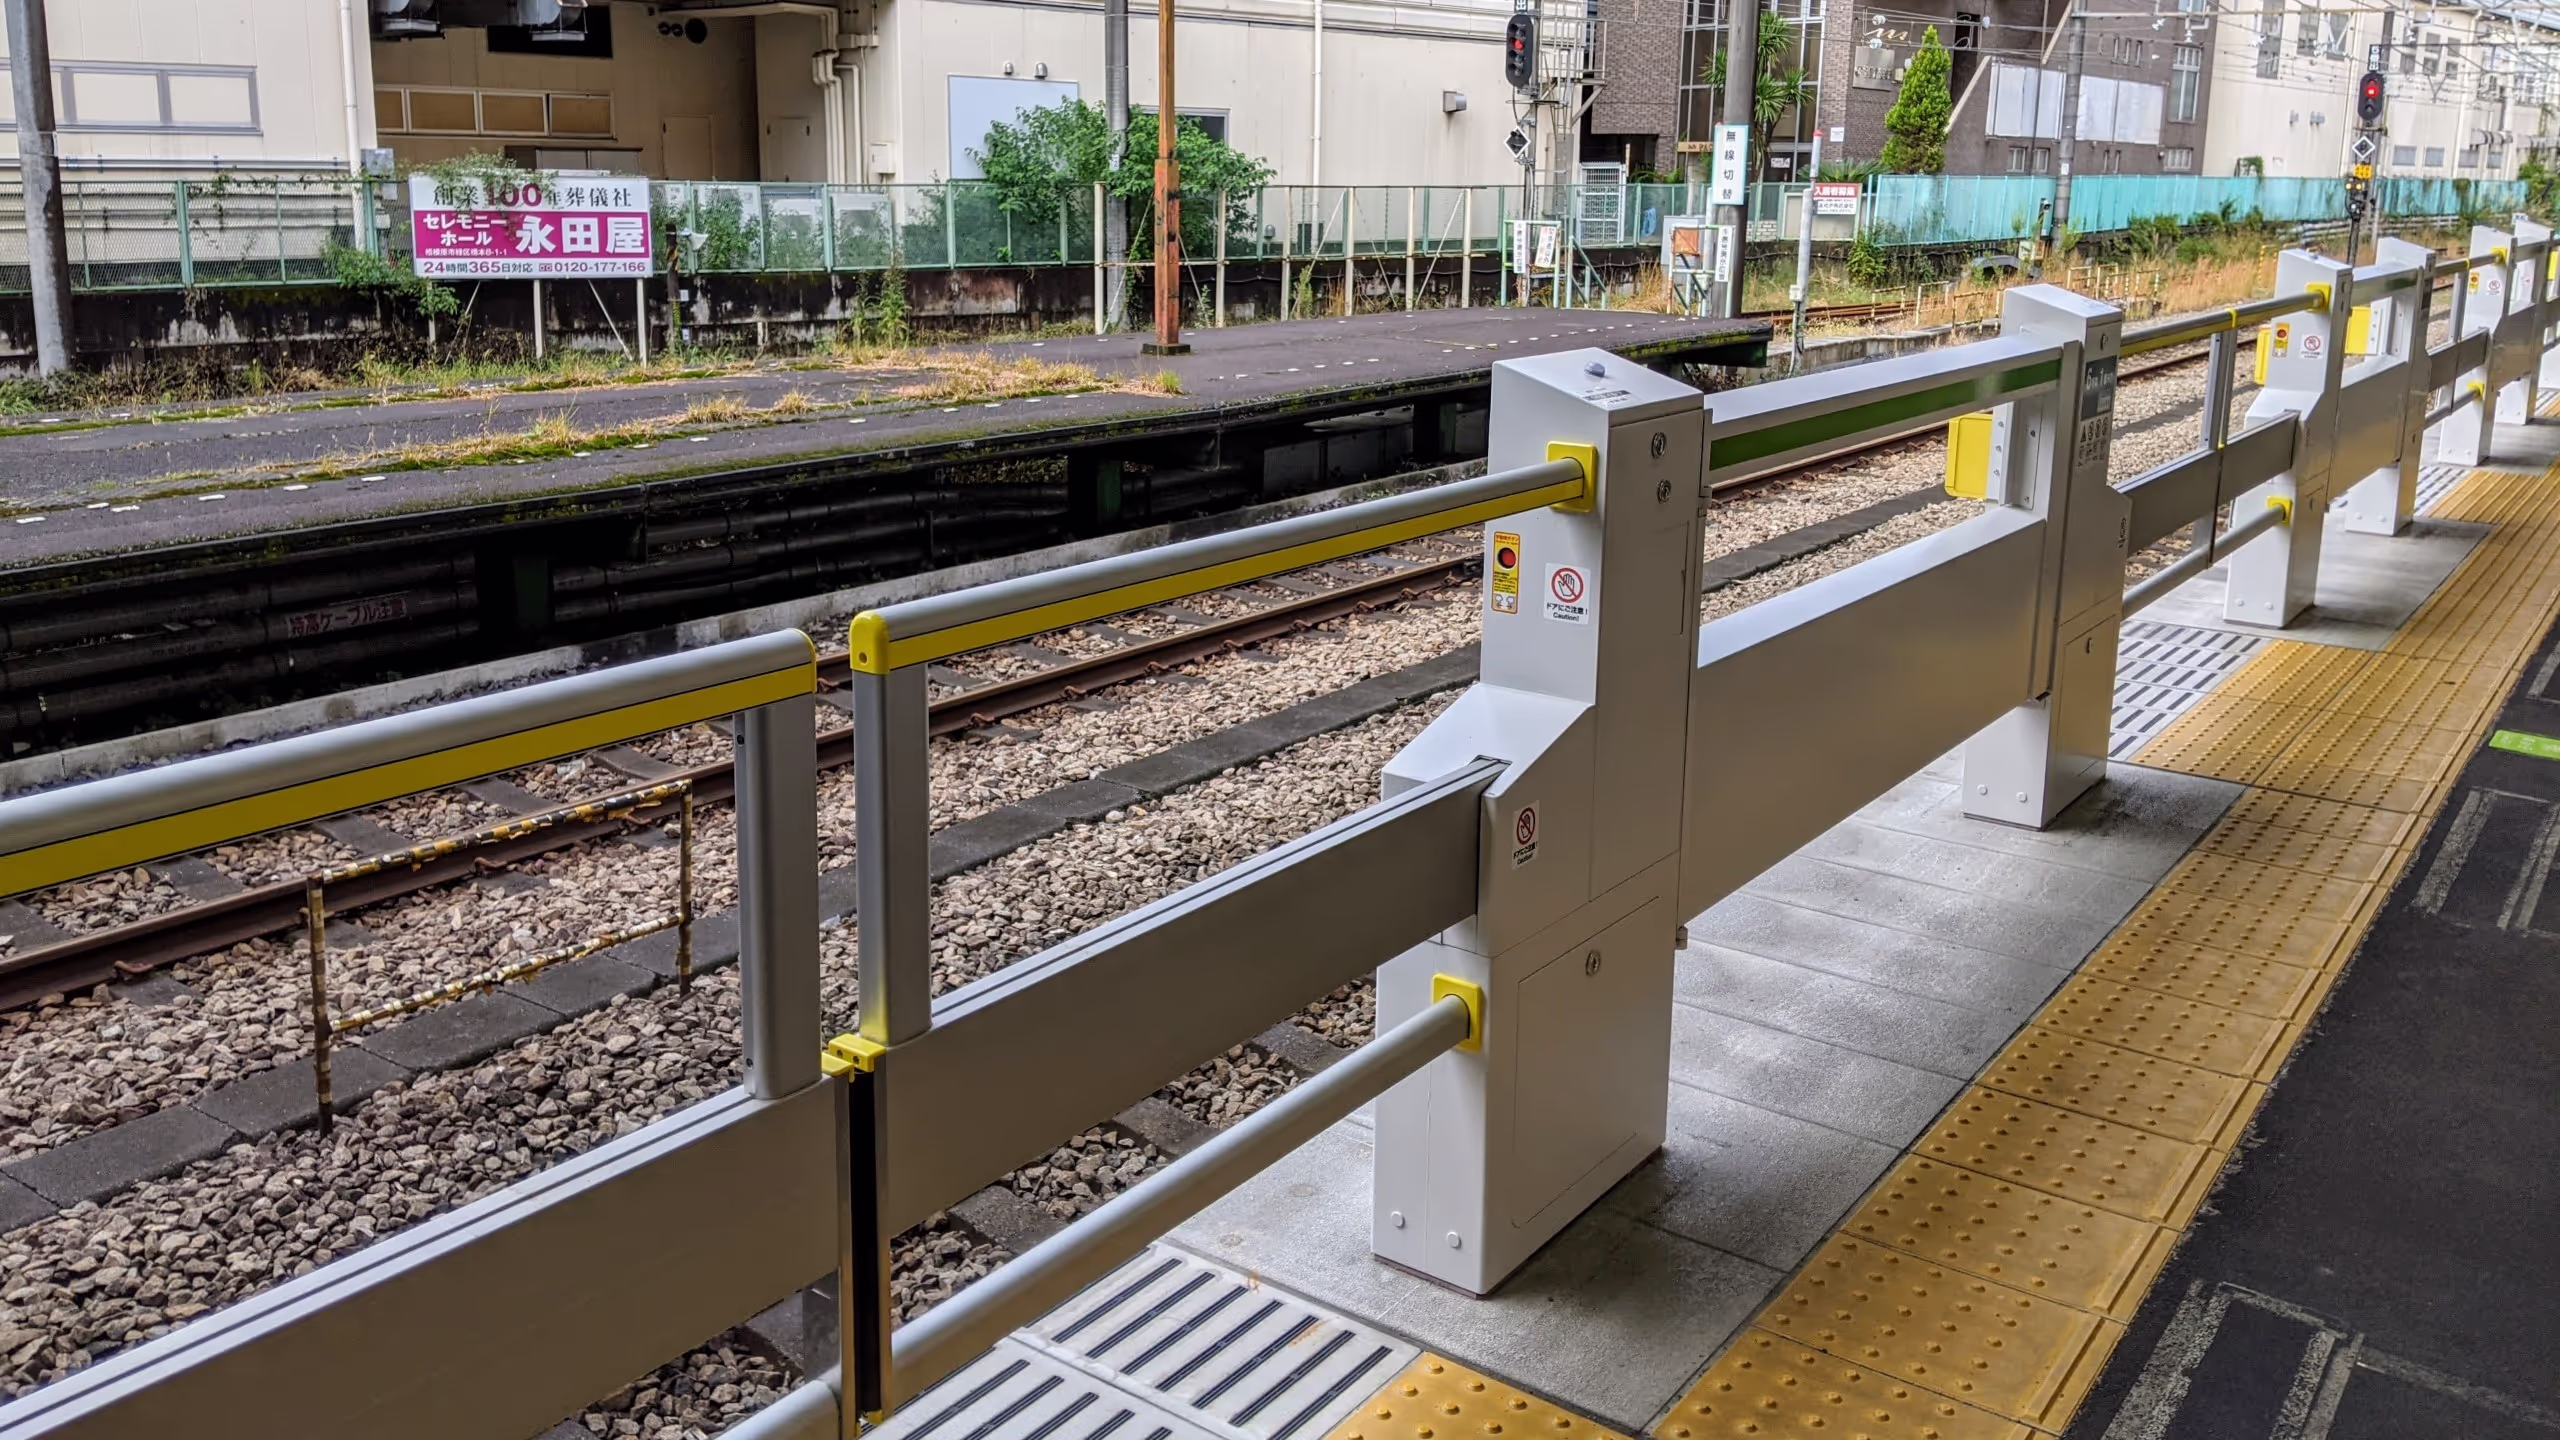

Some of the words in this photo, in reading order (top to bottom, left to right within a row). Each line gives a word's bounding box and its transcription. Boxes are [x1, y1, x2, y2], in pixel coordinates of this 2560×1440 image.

[1722, 130, 1736, 200] 無線切替
[423, 213, 507, 231] セレモニー
[440, 231, 493, 246] ホール
[515, 215, 645, 255] 永田屋
[424, 261, 533, 274] 24時間365日対応
[554, 261, 646, 273] 0120-177-166
[1553, 612, 1580, 622] Caution!
